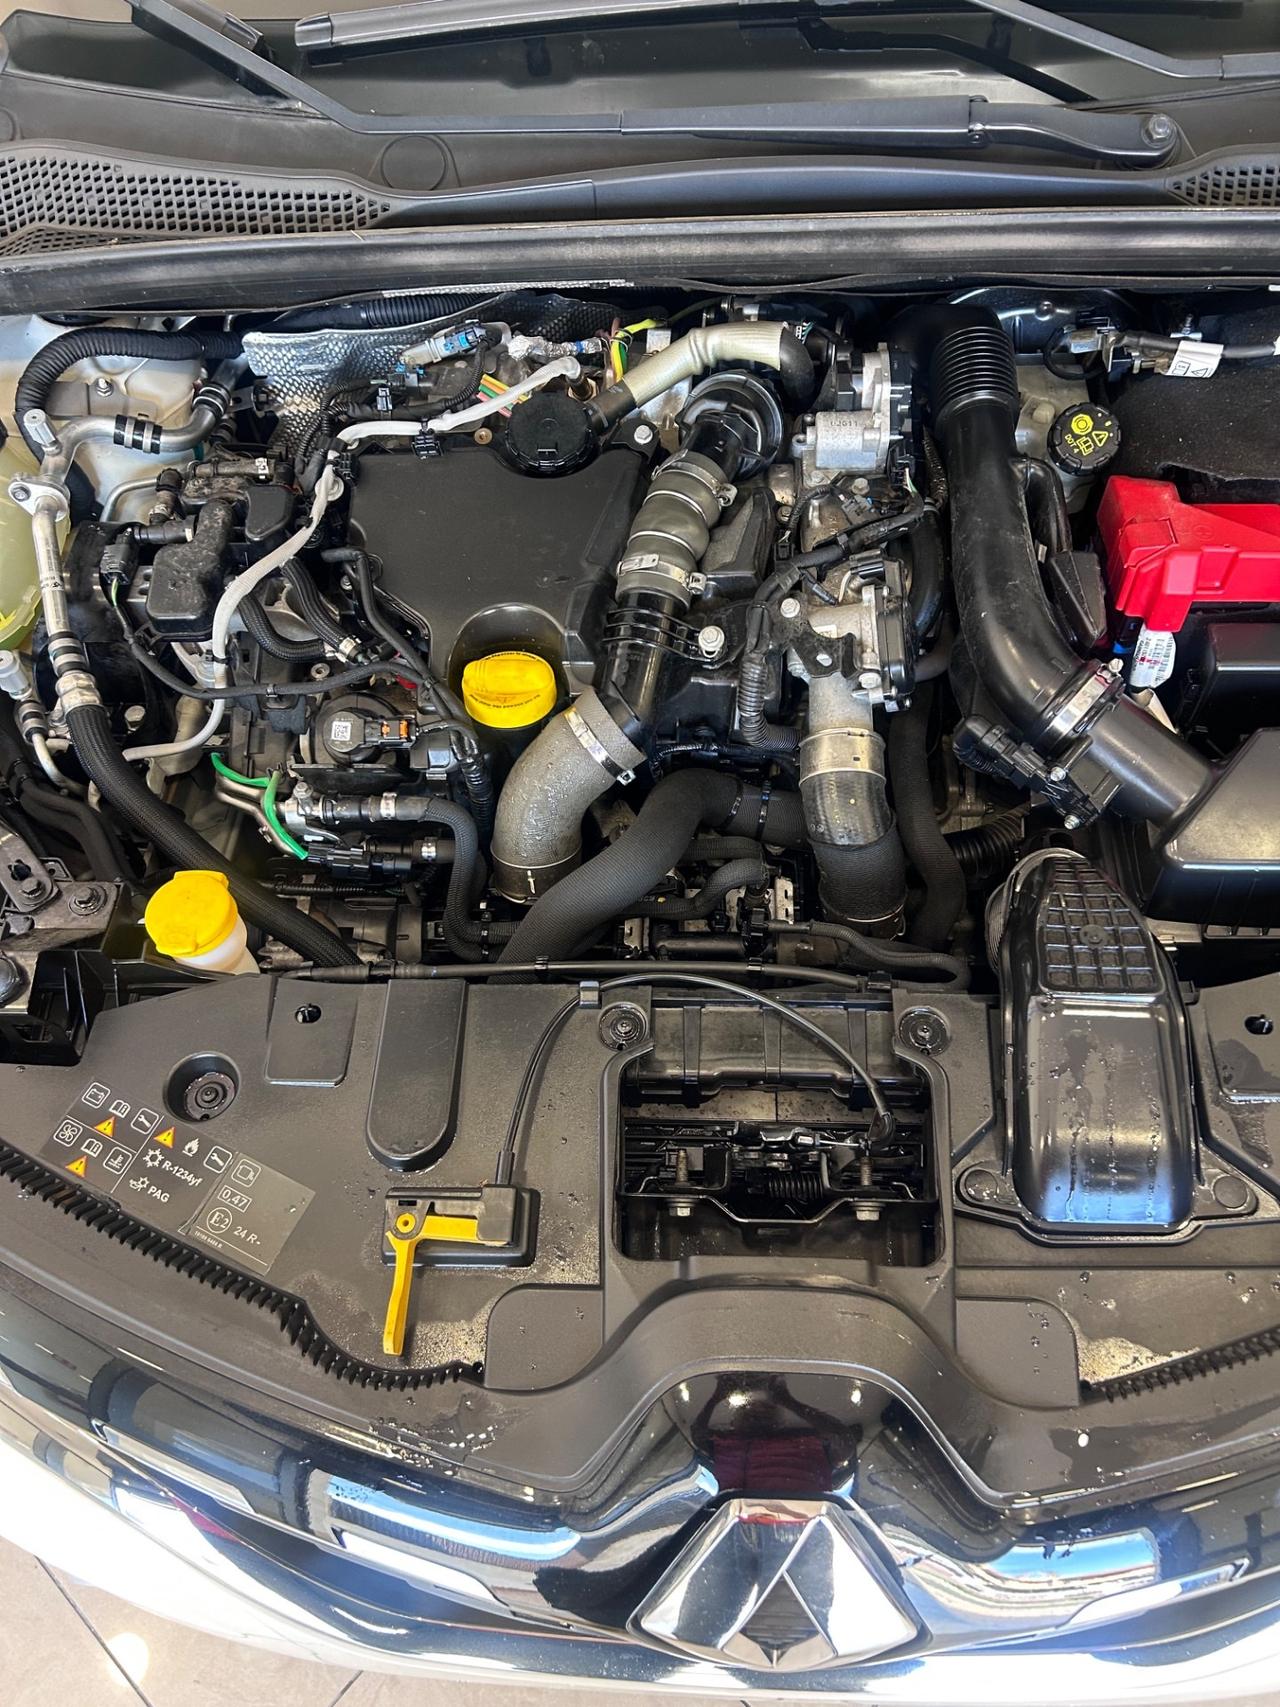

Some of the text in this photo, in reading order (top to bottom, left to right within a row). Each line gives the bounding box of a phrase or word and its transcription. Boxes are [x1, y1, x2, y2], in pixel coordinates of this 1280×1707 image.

[1064, 433, 1077, 447] DOT
[162, 1160, 203, 1186] R-1234yf
[147, 1186, 170, 1203] PAG
[222, 1189, 248, 1208] 0,47
[209, 1211, 229, 1229] E2
[233, 1226, 245, 1239] 24
